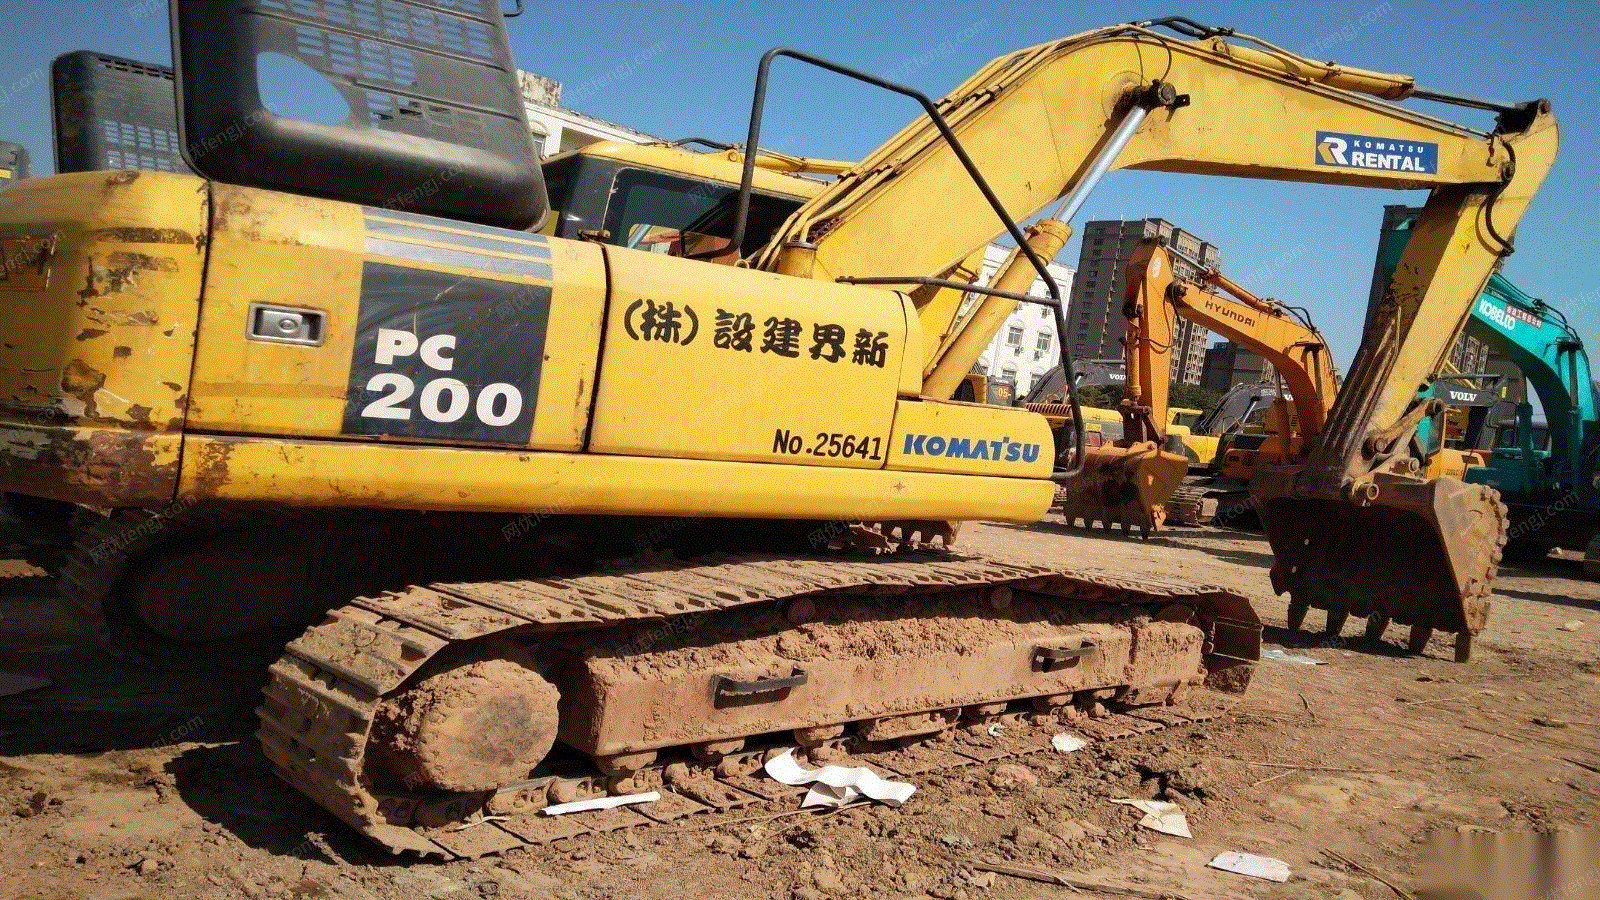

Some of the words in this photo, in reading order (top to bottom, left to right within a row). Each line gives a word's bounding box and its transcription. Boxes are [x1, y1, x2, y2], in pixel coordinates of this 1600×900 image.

[1351, 151, 1426, 172] RENTAL
[1354, 139, 1424, 154] KOMATSU
[1205, 300, 1256, 327] HYUNDAI
[374, 328, 456, 371] PC
[361, 372, 523, 427] 200
[772, 428, 882, 461] No.25641
[903, 433, 1041, 463] KOMATSU
